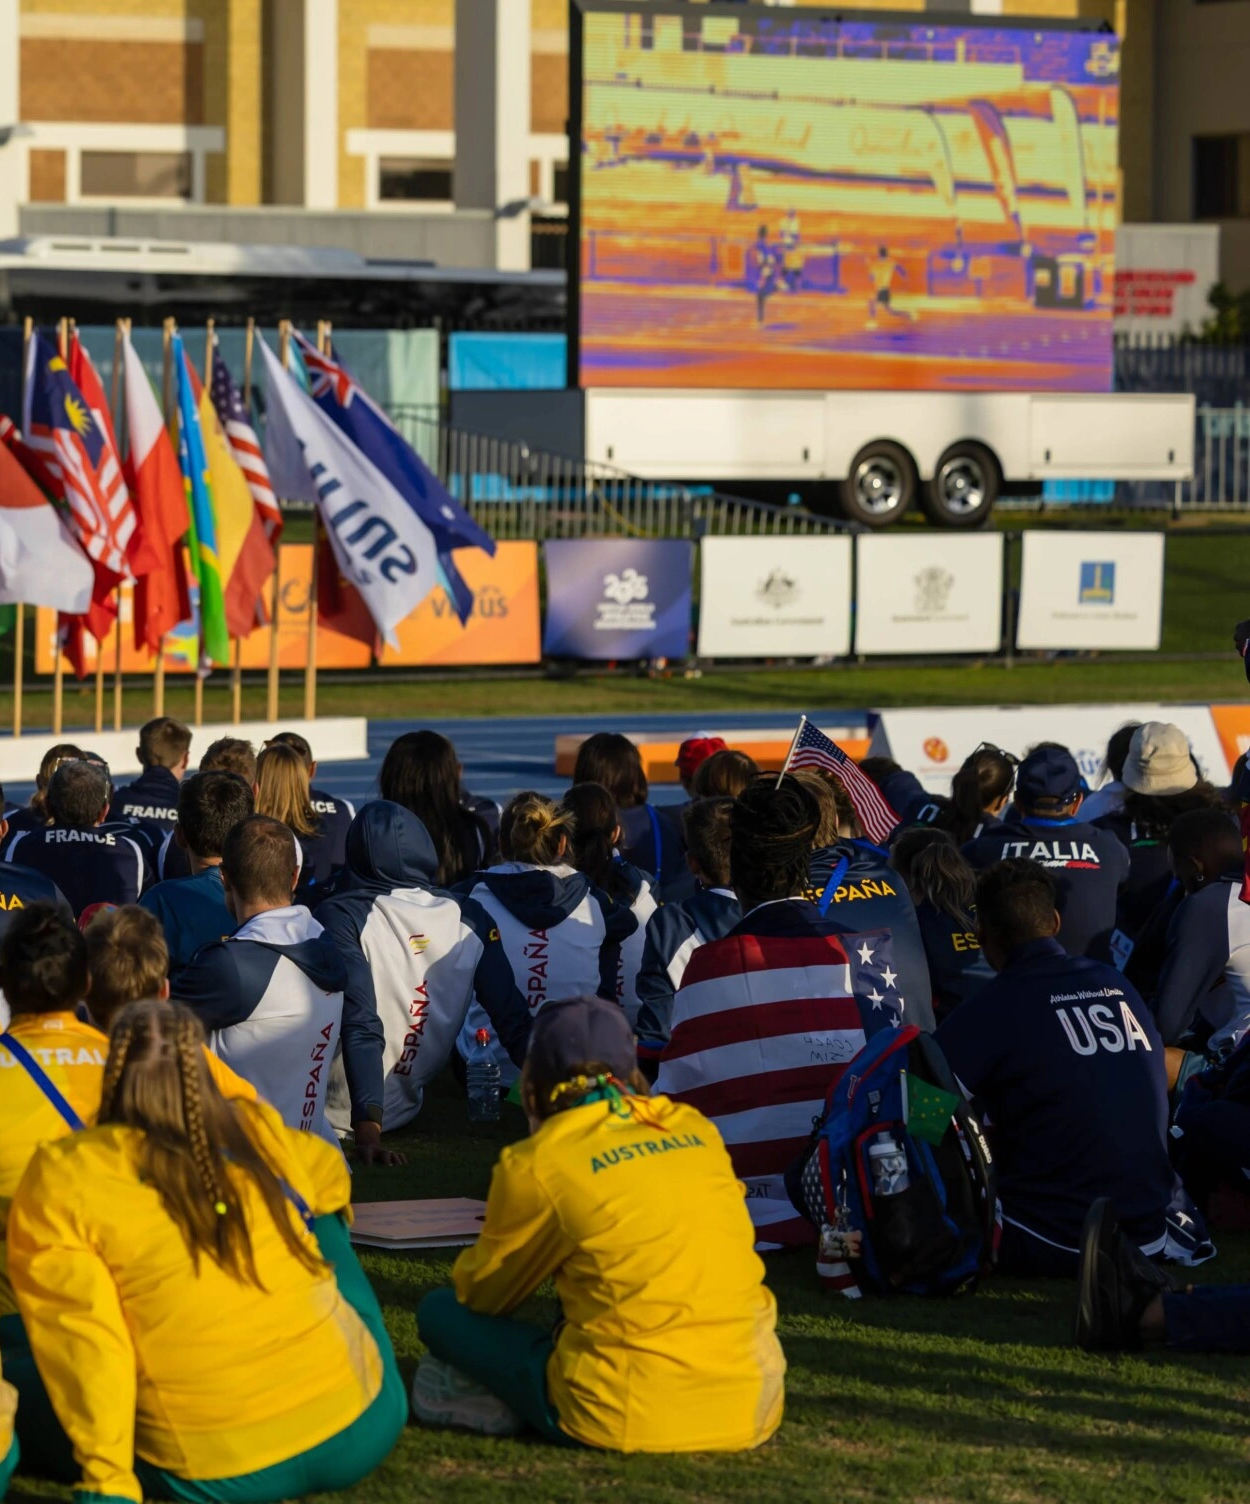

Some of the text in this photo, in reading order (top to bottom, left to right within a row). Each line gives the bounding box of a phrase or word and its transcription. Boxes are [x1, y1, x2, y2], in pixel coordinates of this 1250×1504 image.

[122, 804, 178, 820] FRANC
[1001, 841, 1100, 863] ITALIA
[523, 928, 549, 1009] SPAÑA
[1050, 987, 1124, 1004] Athletes Without Limits
[393, 980, 431, 1076] ESPAÑA
[1055, 1001, 1152, 1056] USA
[591, 1134, 705, 1174] AUSTRALIA
